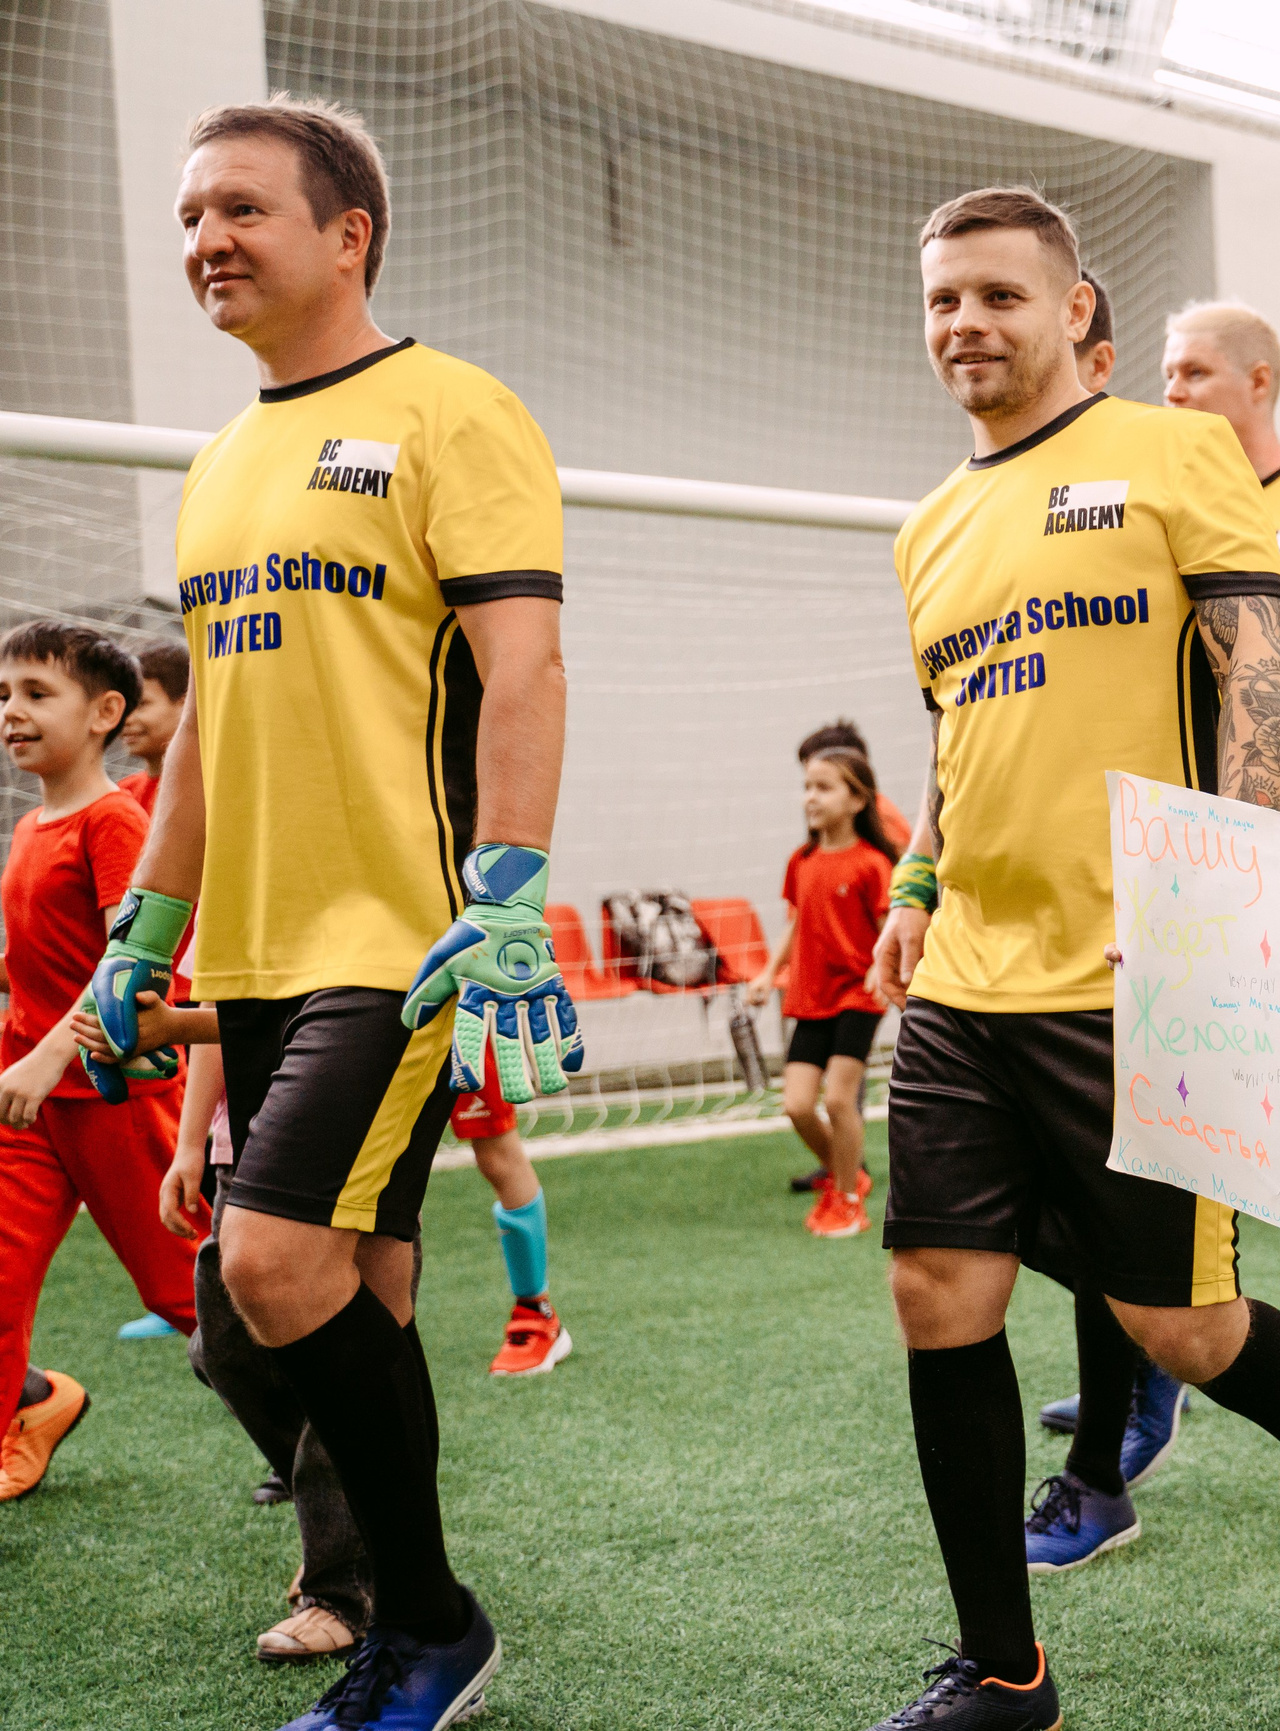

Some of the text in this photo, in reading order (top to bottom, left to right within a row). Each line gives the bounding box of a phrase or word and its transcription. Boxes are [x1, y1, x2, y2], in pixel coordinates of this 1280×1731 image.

[318, 438, 343, 463] BC
[306, 466, 394, 499] ACADEMY
[1048, 485, 1070, 510] BC
[1043, 502, 1126, 536] ACADEMY
[179, 552, 387, 616] жлаука School
[207, 611, 282, 660] UNITED
[920, 587, 1149, 680] ежлаука School
[955, 652, 1046, 707] UNITED
[1119, 777, 1262, 908] Вашу
[1129, 975, 1275, 1058] Желаем
[1129, 1072, 1271, 1168] Счастья
